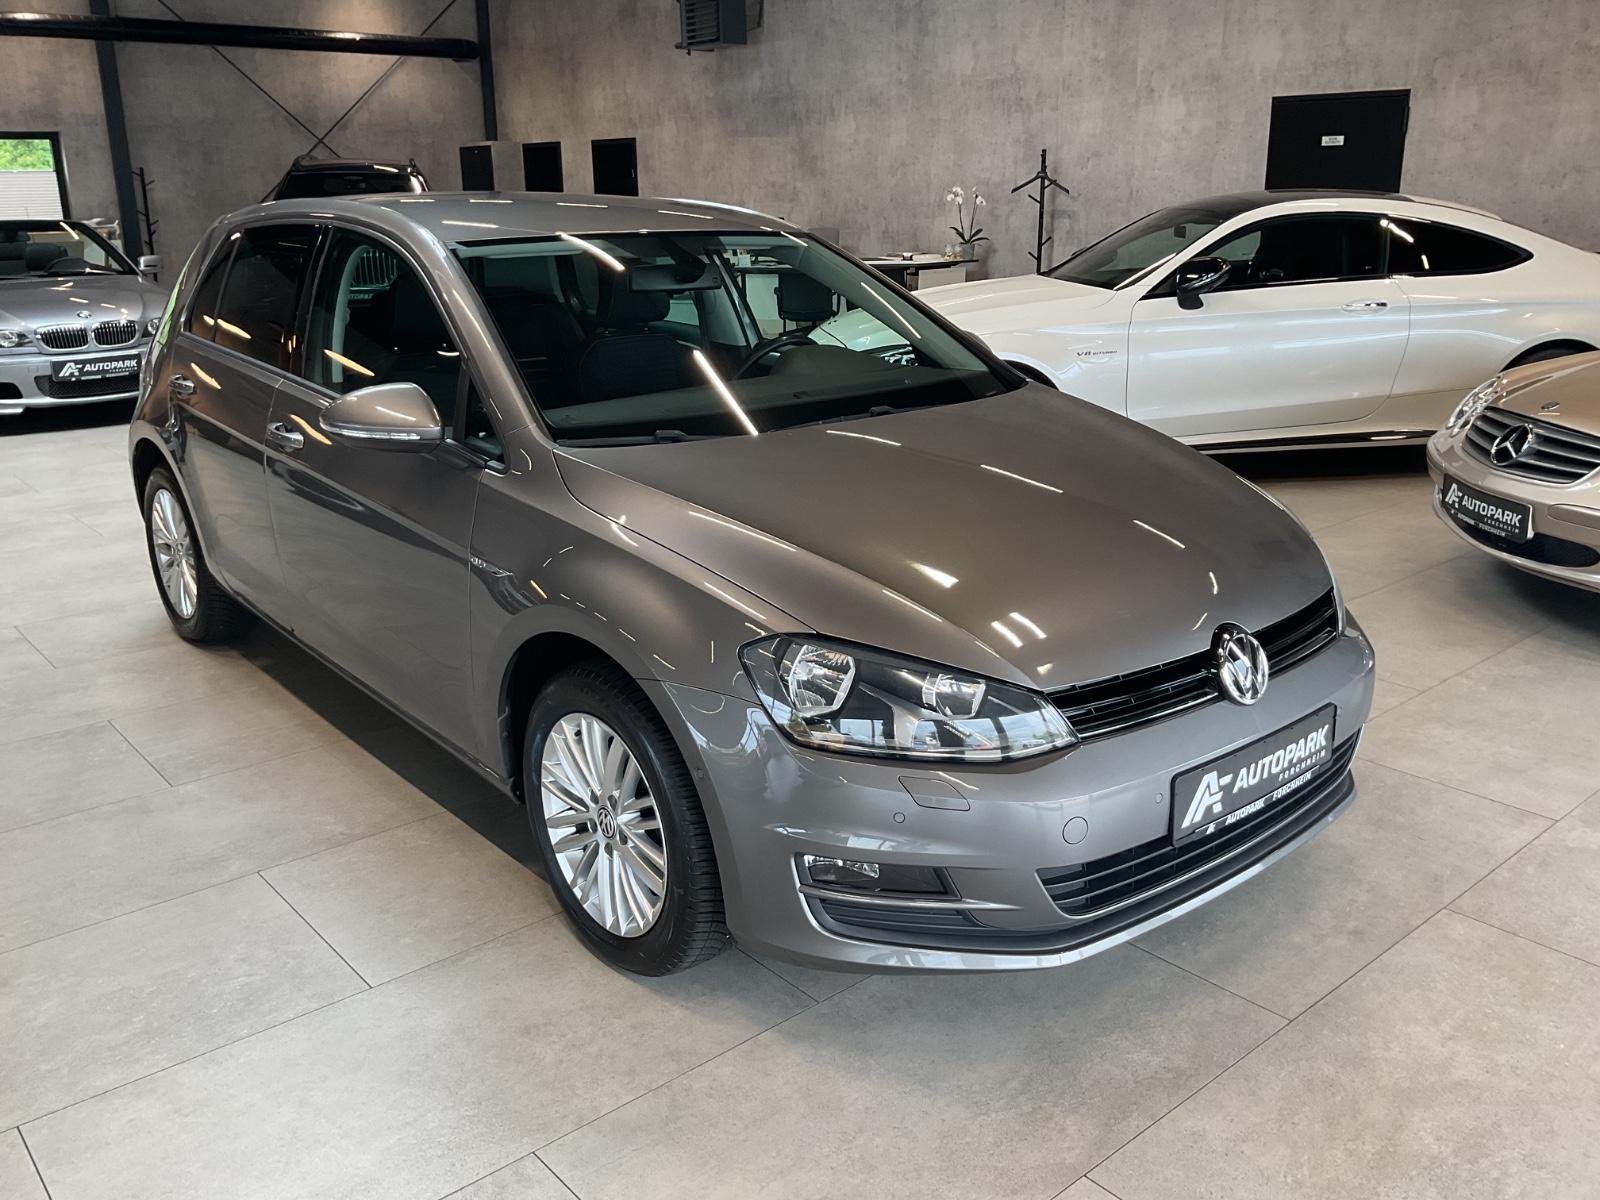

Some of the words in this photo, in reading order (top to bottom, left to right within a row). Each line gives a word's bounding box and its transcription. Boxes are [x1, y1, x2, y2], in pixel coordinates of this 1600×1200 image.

[83, 360, 137, 371] AUTOPARK
[1462, 496, 1522, 527] AUTOPARK
[1232, 724, 1329, 793] AUTOPARK
[1278, 749, 1326, 782] FORCHHEIM
[1225, 798, 1265, 825] AUTOPARK
[1272, 773, 1312, 801] FORCHHEIM
